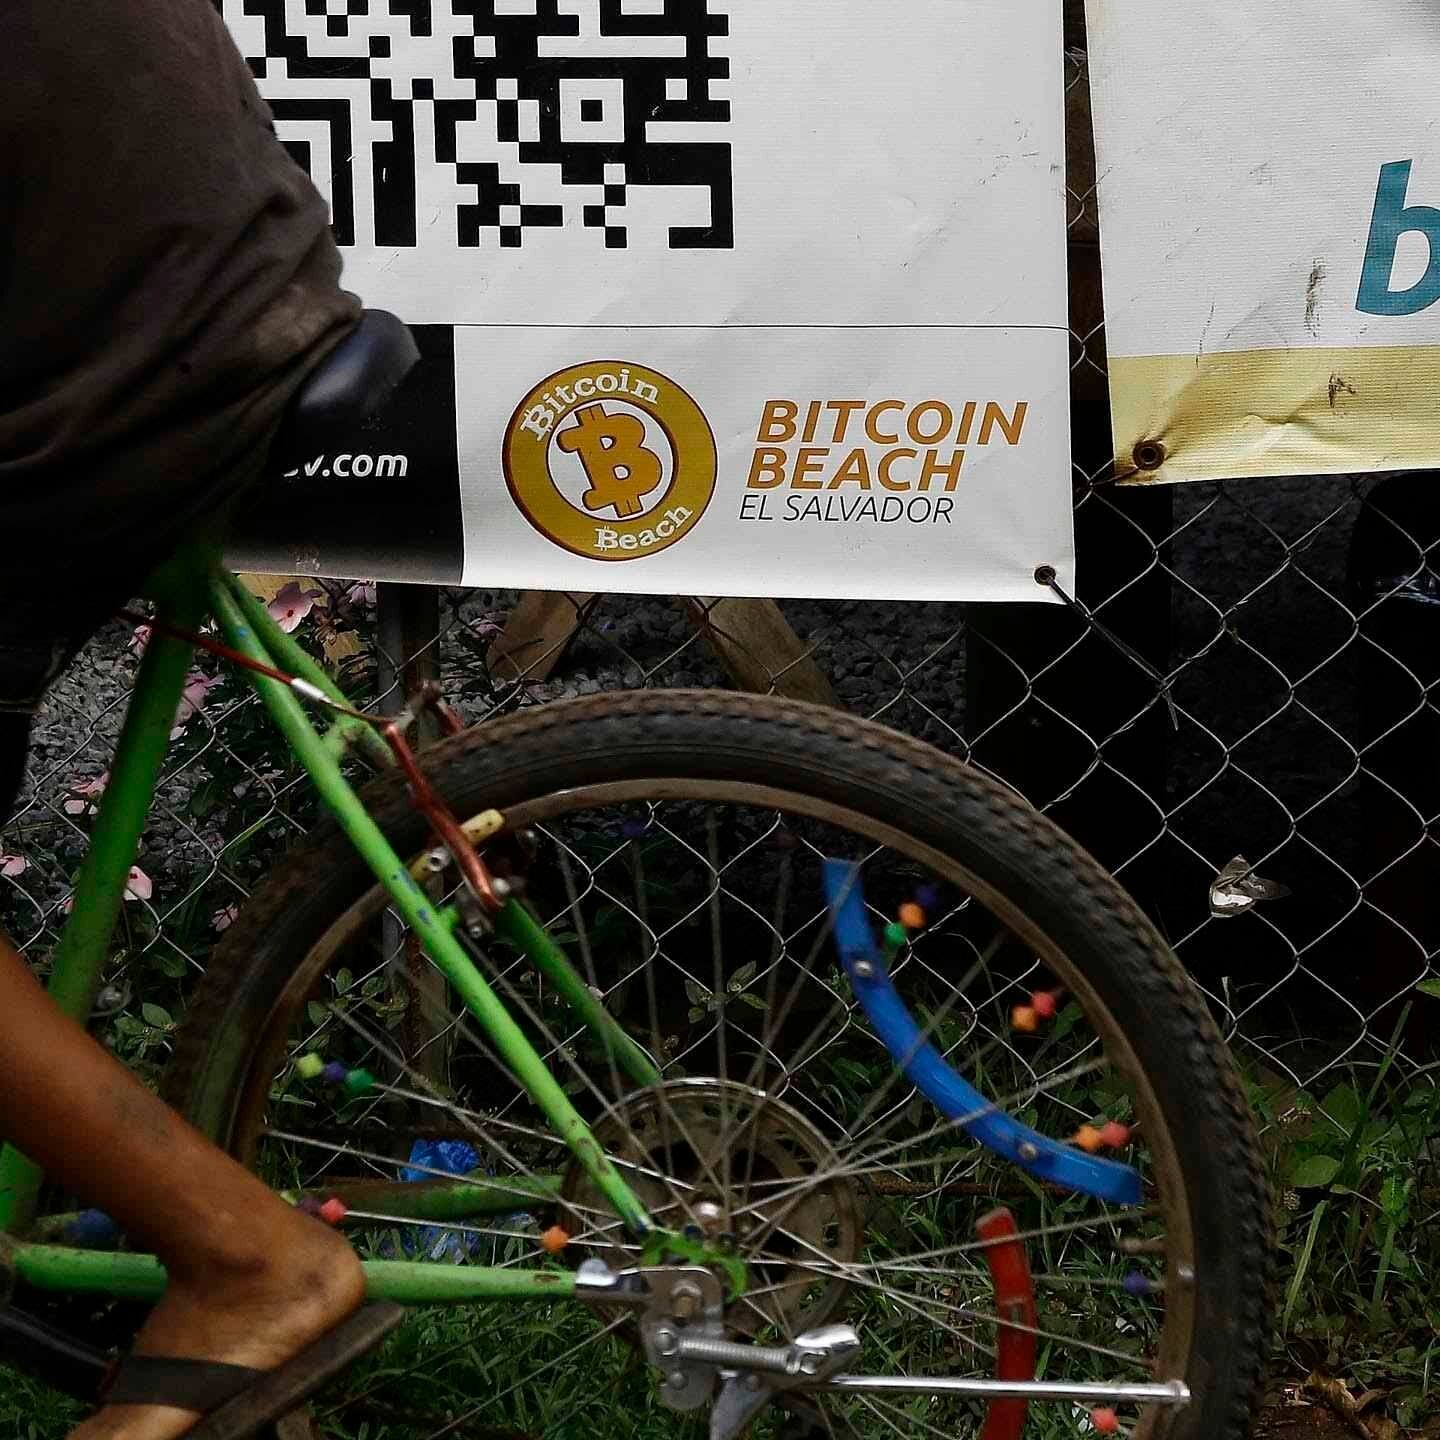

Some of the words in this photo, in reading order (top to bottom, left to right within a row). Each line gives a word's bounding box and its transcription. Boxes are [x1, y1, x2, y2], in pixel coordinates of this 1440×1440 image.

[519, 366, 661, 444] Bitcoin
[755, 399, 1030, 447] BITCOIN
[745, 447, 968, 493] BEACH
[594, 501, 694, 552] Beach
[738, 495, 778, 521] EL
[782, 495, 954, 525] SALVADOR
